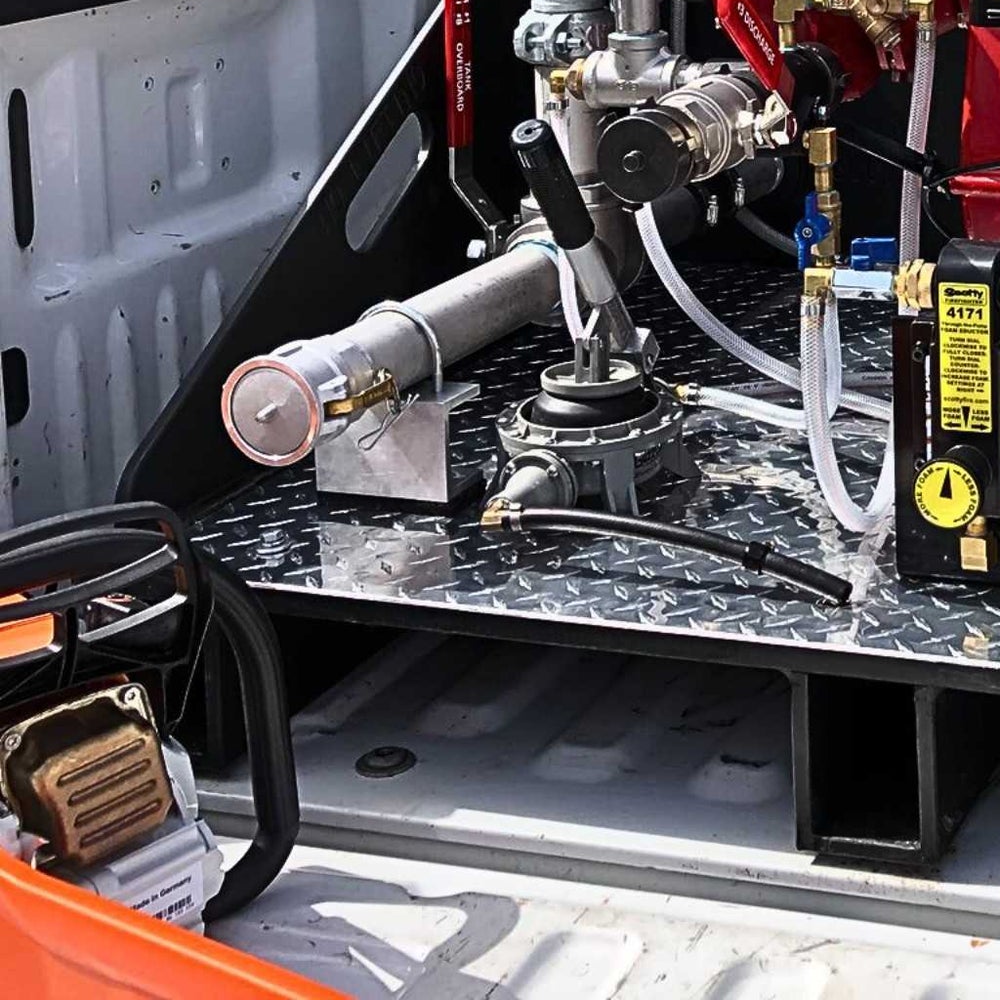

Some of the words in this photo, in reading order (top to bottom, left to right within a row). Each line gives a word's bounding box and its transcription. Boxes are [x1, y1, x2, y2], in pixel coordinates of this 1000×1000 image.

[744, 10, 776, 66] DISCHARGE
[456, 42, 464, 112] OVERBOARD
[464, 61, 472, 91] TANK
[944, 288, 984, 299] Scotty
[946, 307, 983, 320] 4171
[917, 467, 935, 489] FOAM
[962, 474, 976, 497] LESS
[961, 498, 976, 521] FOAM
[151, 894, 159, 902] in
[160, 875, 192, 897] Germany
